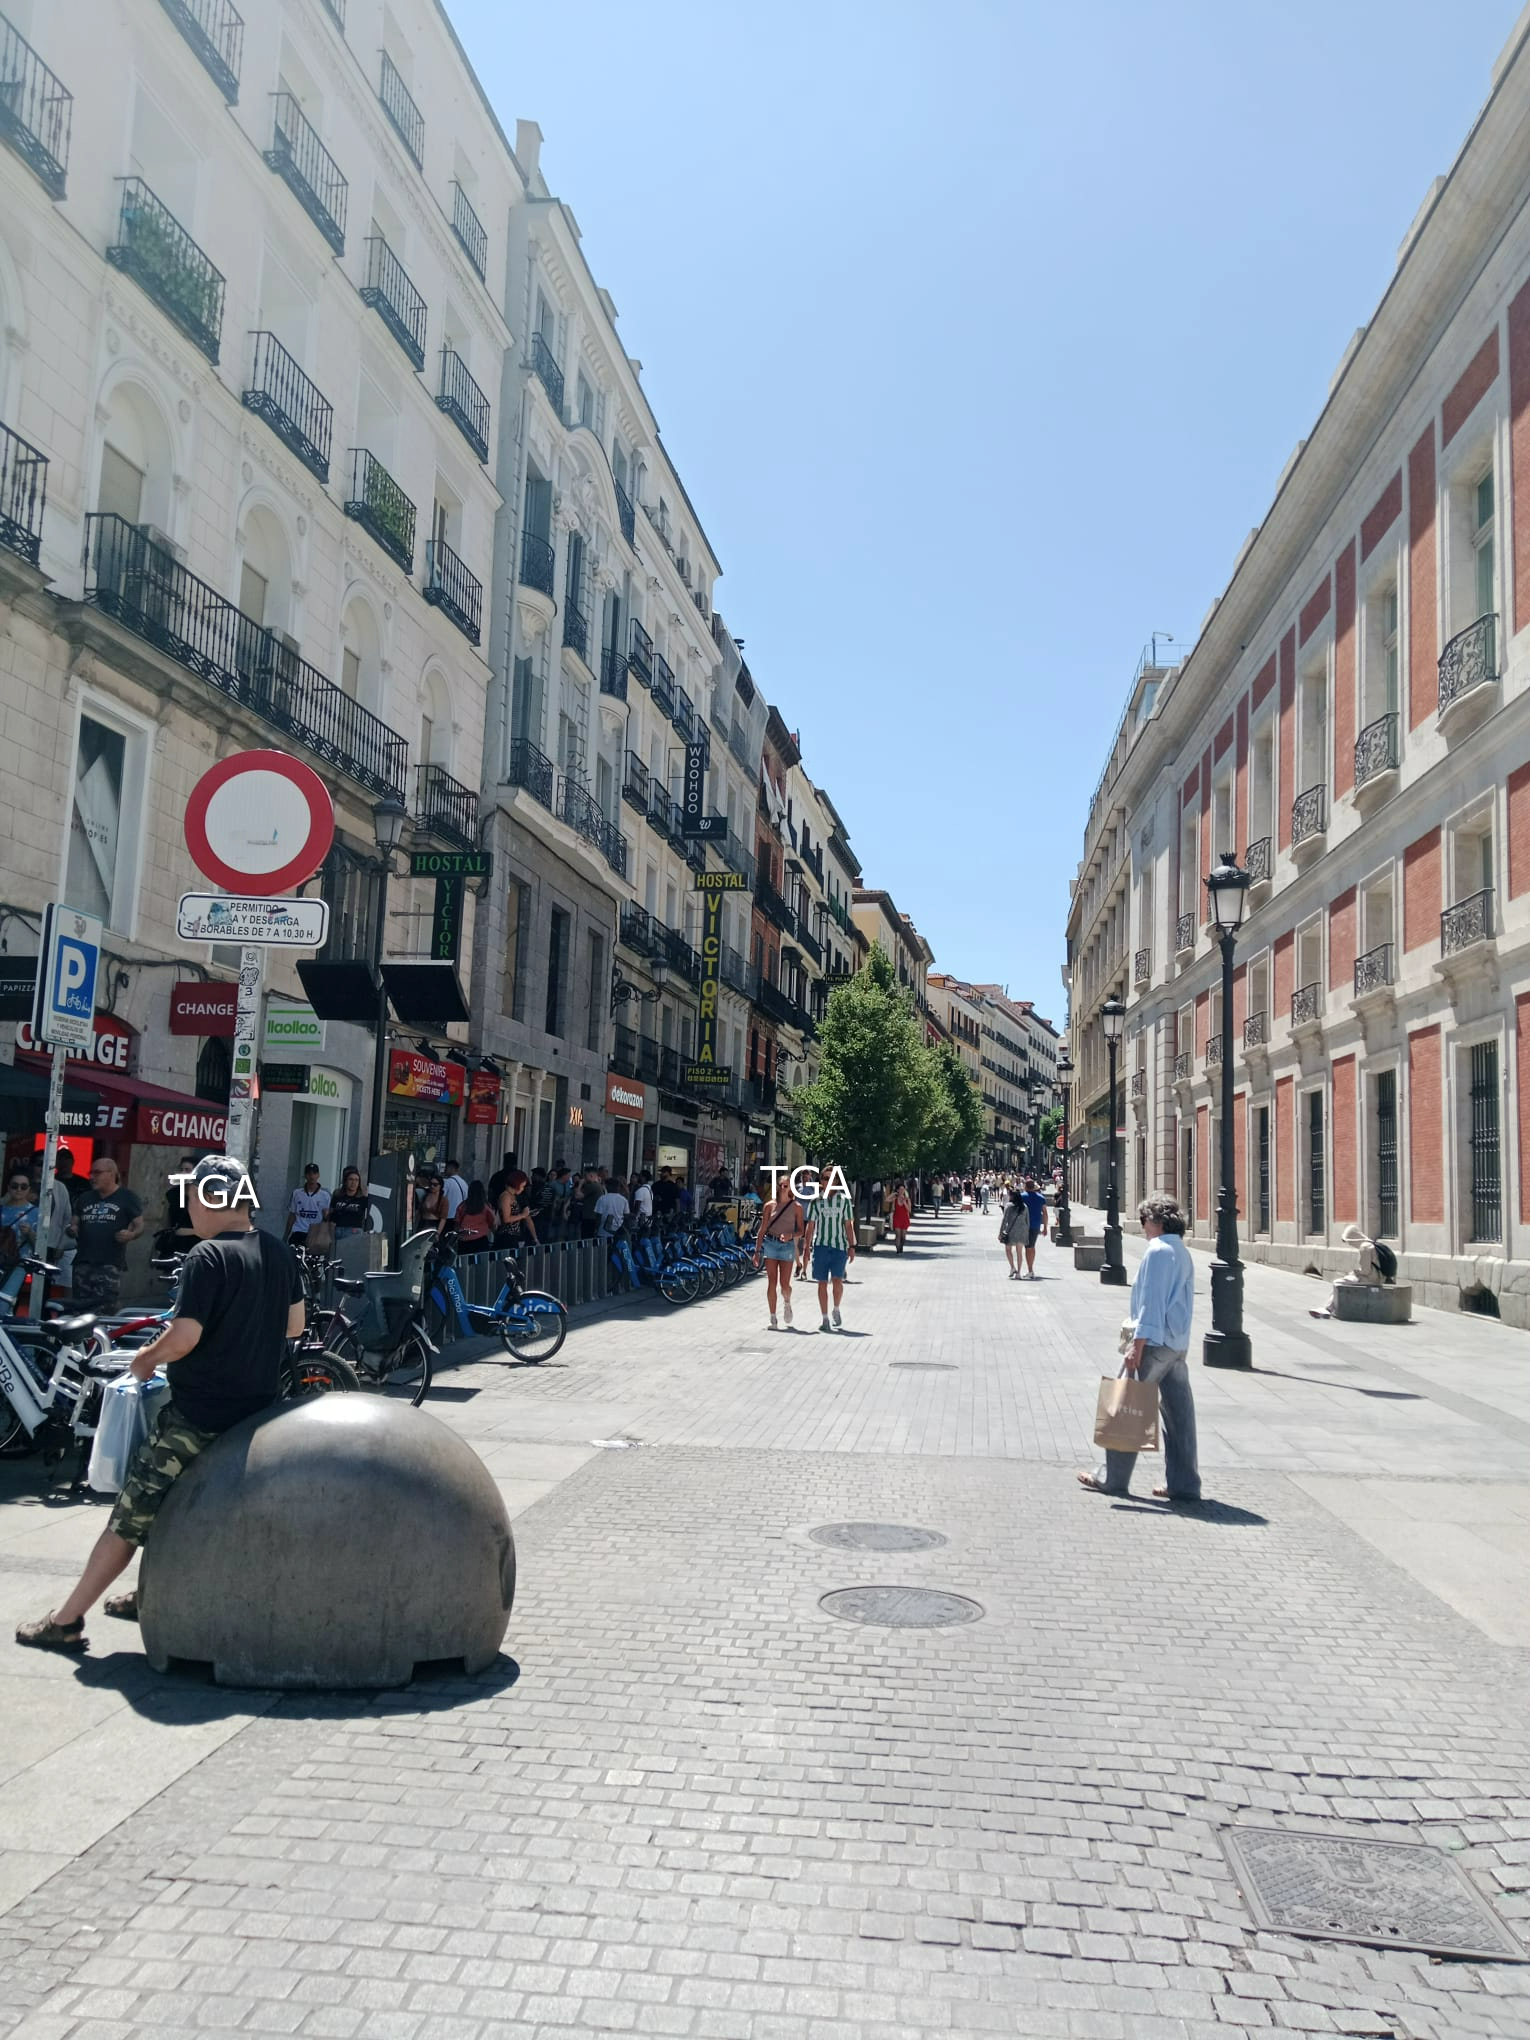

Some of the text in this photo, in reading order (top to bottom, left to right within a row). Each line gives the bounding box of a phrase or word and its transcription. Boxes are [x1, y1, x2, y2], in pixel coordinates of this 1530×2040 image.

[688, 747, 702, 814] WOOHOO
[415, 855, 487, 872] HOSTAL
[697, 873, 746, 888] HOSTAL
[241, 915, 247, 924] Y
[249, 915, 300, 927] DESCARGA
[251, 927, 264, 937] DE
[266, 927, 272, 937] 7
[273, 928, 280, 937] A
[282, 928, 304, 940] 10,30
[57, 944, 87, 1007] P
[699, 893, 721, 1063] VICTORIA
[176, 1002, 234, 1016] CHANGE
[413, 1058, 447, 1079] SOUVENIRS
[611, 1085, 644, 1109] dekorazon
[45, 1111, 91, 1126] CRETAS 3
